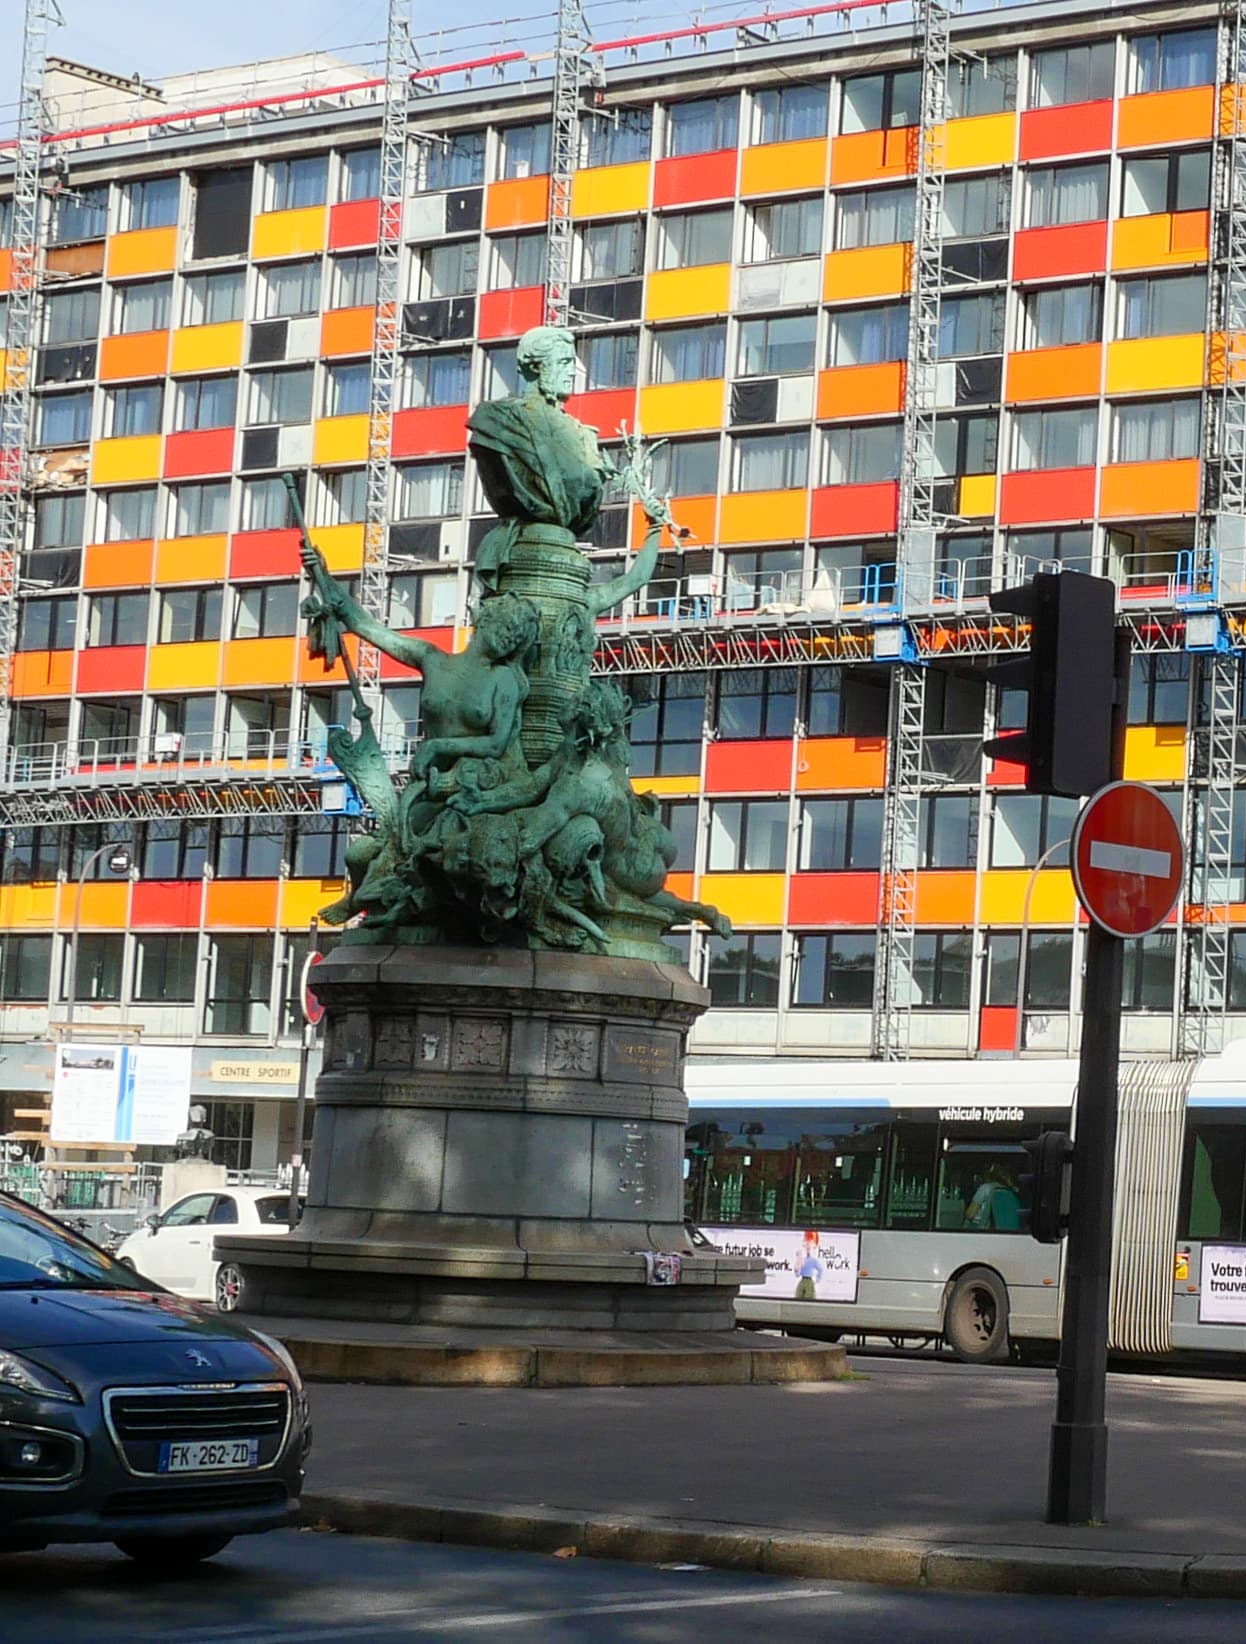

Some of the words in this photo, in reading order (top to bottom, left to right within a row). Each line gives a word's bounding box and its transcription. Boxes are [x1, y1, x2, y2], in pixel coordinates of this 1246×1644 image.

[219, 1066, 250, 1077] CENTRE
[258, 1067, 292, 1078] SPORTIF
[939, 1106, 981, 1120] véhicule
[983, 1106, 1025, 1123] hybride
[764, 1247, 775, 1257] se
[1211, 1263, 1242, 1277] Votre
[170, 1443, 249, 1467] FK-262-ZD
